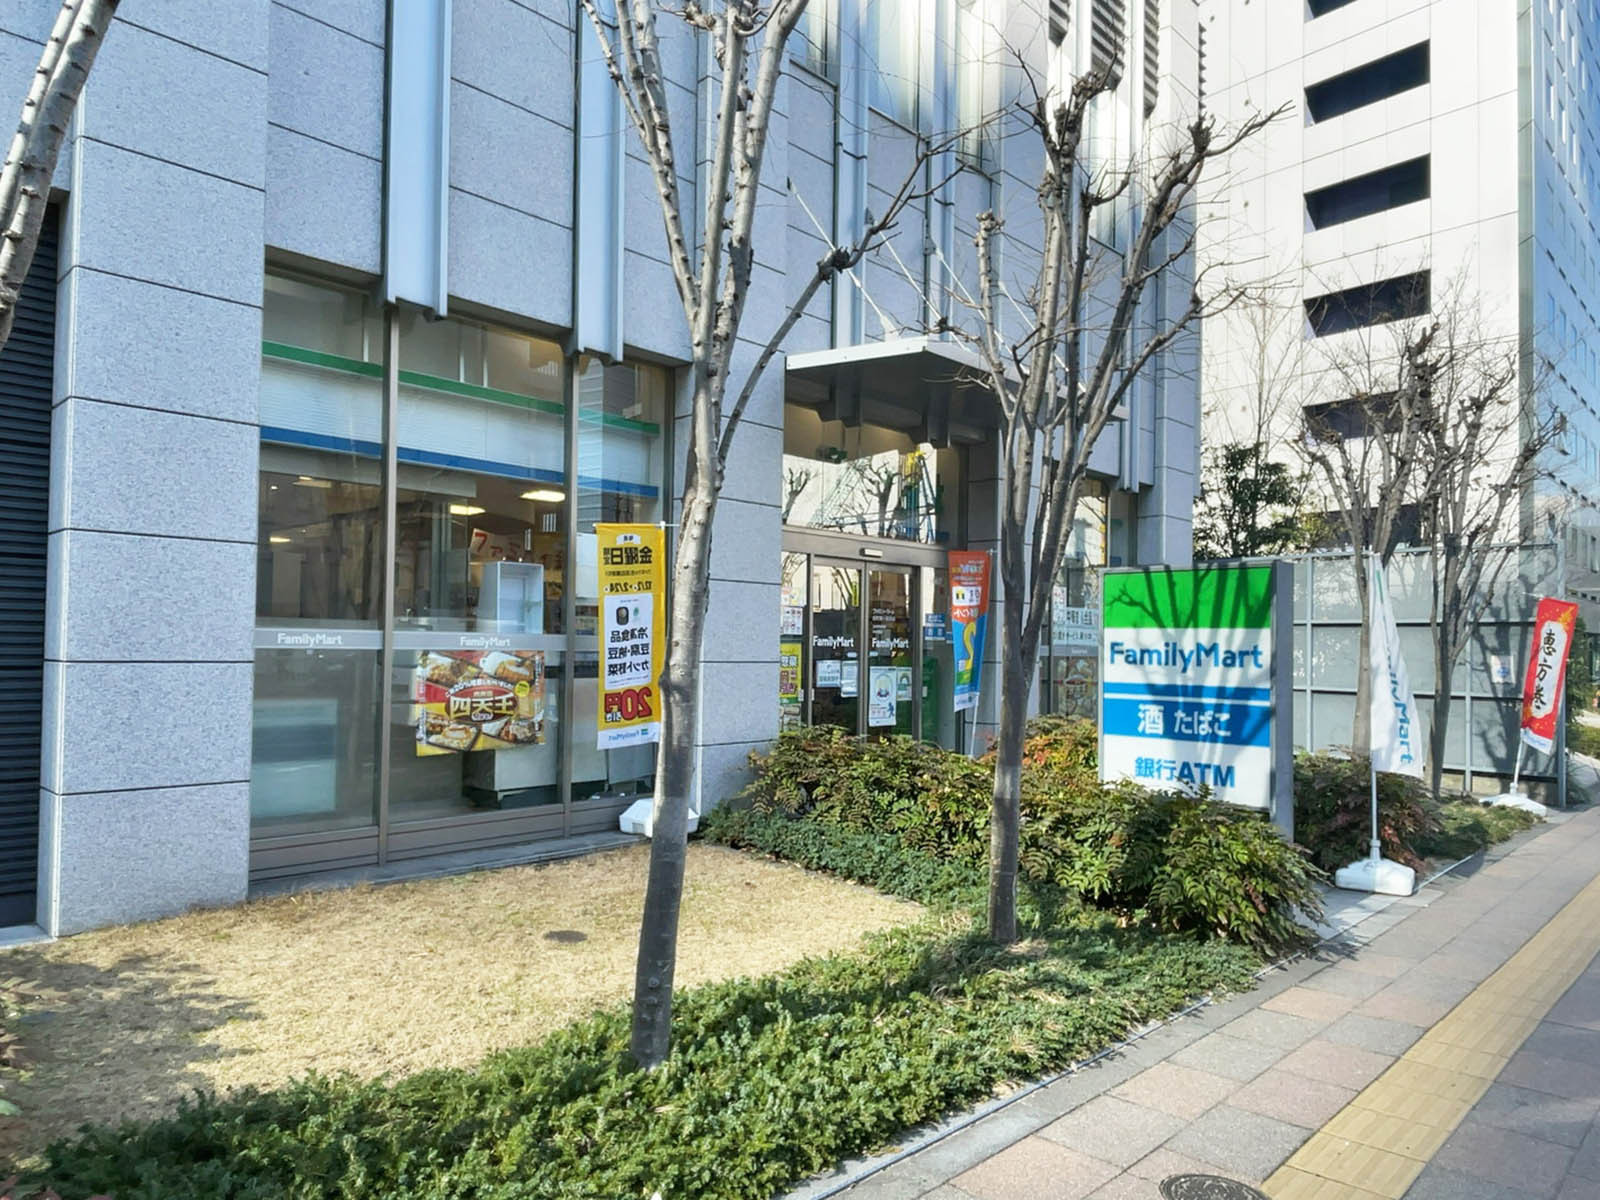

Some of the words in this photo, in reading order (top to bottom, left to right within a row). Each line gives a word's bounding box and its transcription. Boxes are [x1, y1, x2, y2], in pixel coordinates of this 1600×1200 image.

[277, 632, 342, 648] FamilyMart
[460, 636, 511, 649] FamilyMart
[812, 635, 854, 649] FamilyMart
[871, 637, 909, 650] FamilyMart
[1109, 641, 1264, 674] FamilyMart
[450, 697, 515, 720] 四天王
[1137, 703, 1164, 735] 酒
[1174, 710, 1232, 737] たばこ
[1135, 756, 1236, 788] 銀行ATM
